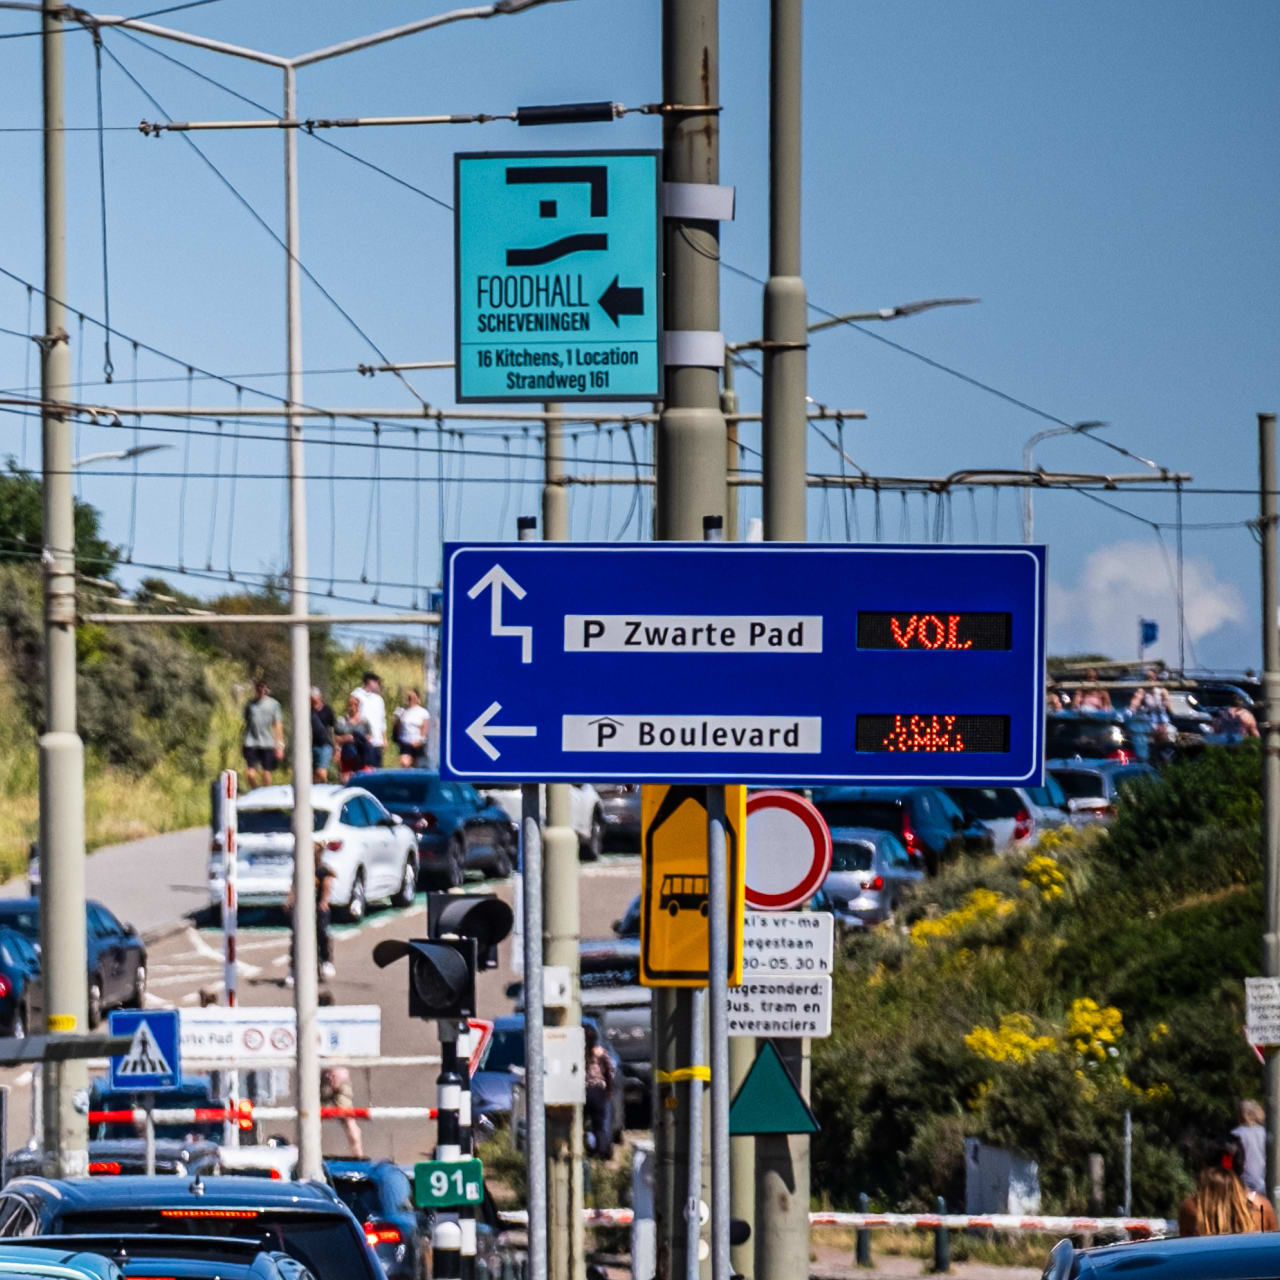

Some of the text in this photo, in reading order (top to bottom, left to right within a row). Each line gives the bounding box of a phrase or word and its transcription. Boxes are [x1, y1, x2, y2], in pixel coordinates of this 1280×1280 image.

[477, 274, 589, 308] FOODHALL
[477, 312, 590, 332] SCHEVENINGEN
[477, 346, 639, 369] 16 Kitchens, 1 Location
[506, 370, 610, 392] Strandweg 161
[624, 620, 737, 648] Zwarte
[749, 620, 805, 648] Pad
[890, 614, 972, 650] VOL
[639, 721, 801, 748] Boulevard
[747, 937, 814, 951] egestaan
[819, 959, 828, 970] h
[728, 983, 823, 996] itgezonderd:
[760, 1000, 797, 1012] tram
[803, 1003, 820, 1013] en
[729, 1018, 816, 1031] everanciers
[430, 1169, 464, 1197] 91
